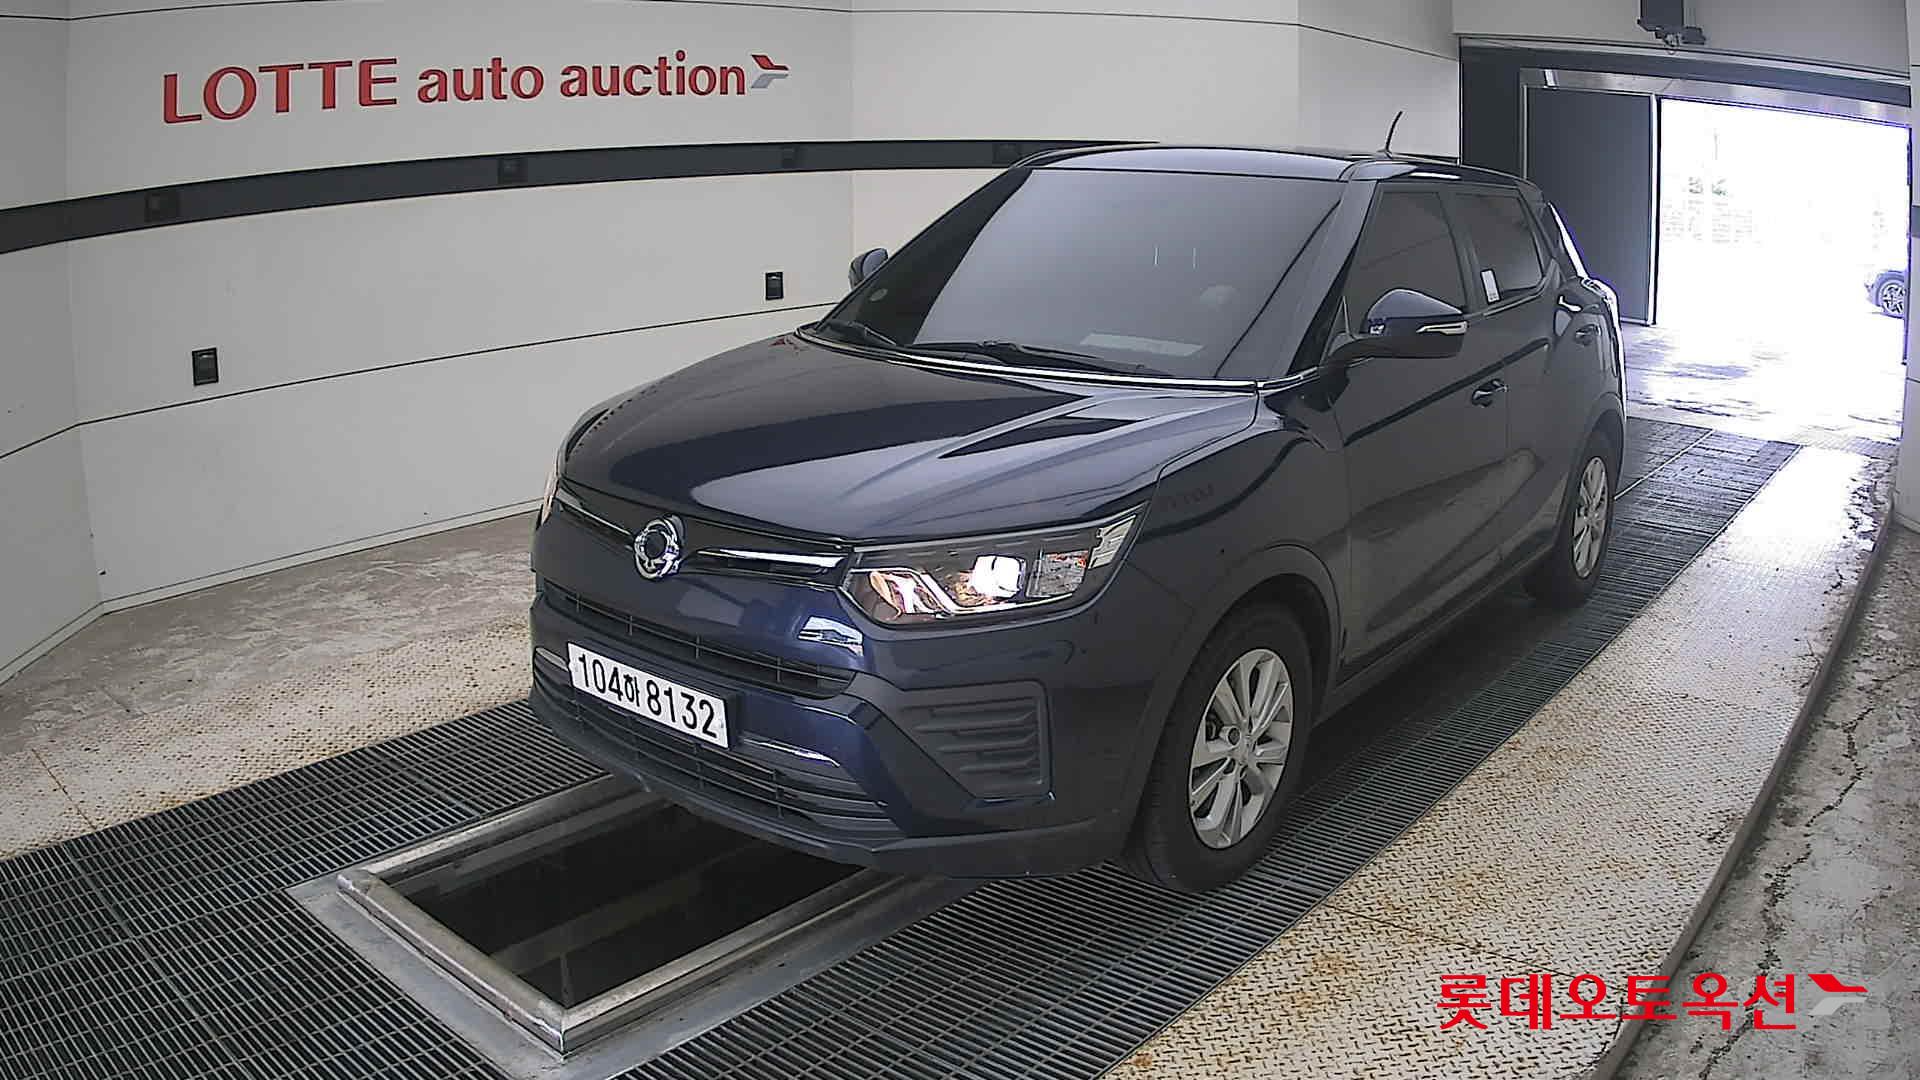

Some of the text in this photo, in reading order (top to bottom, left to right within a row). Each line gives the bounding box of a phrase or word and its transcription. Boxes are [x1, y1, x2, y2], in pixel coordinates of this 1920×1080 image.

[163, 50, 746, 124] LOTTE auto auction
